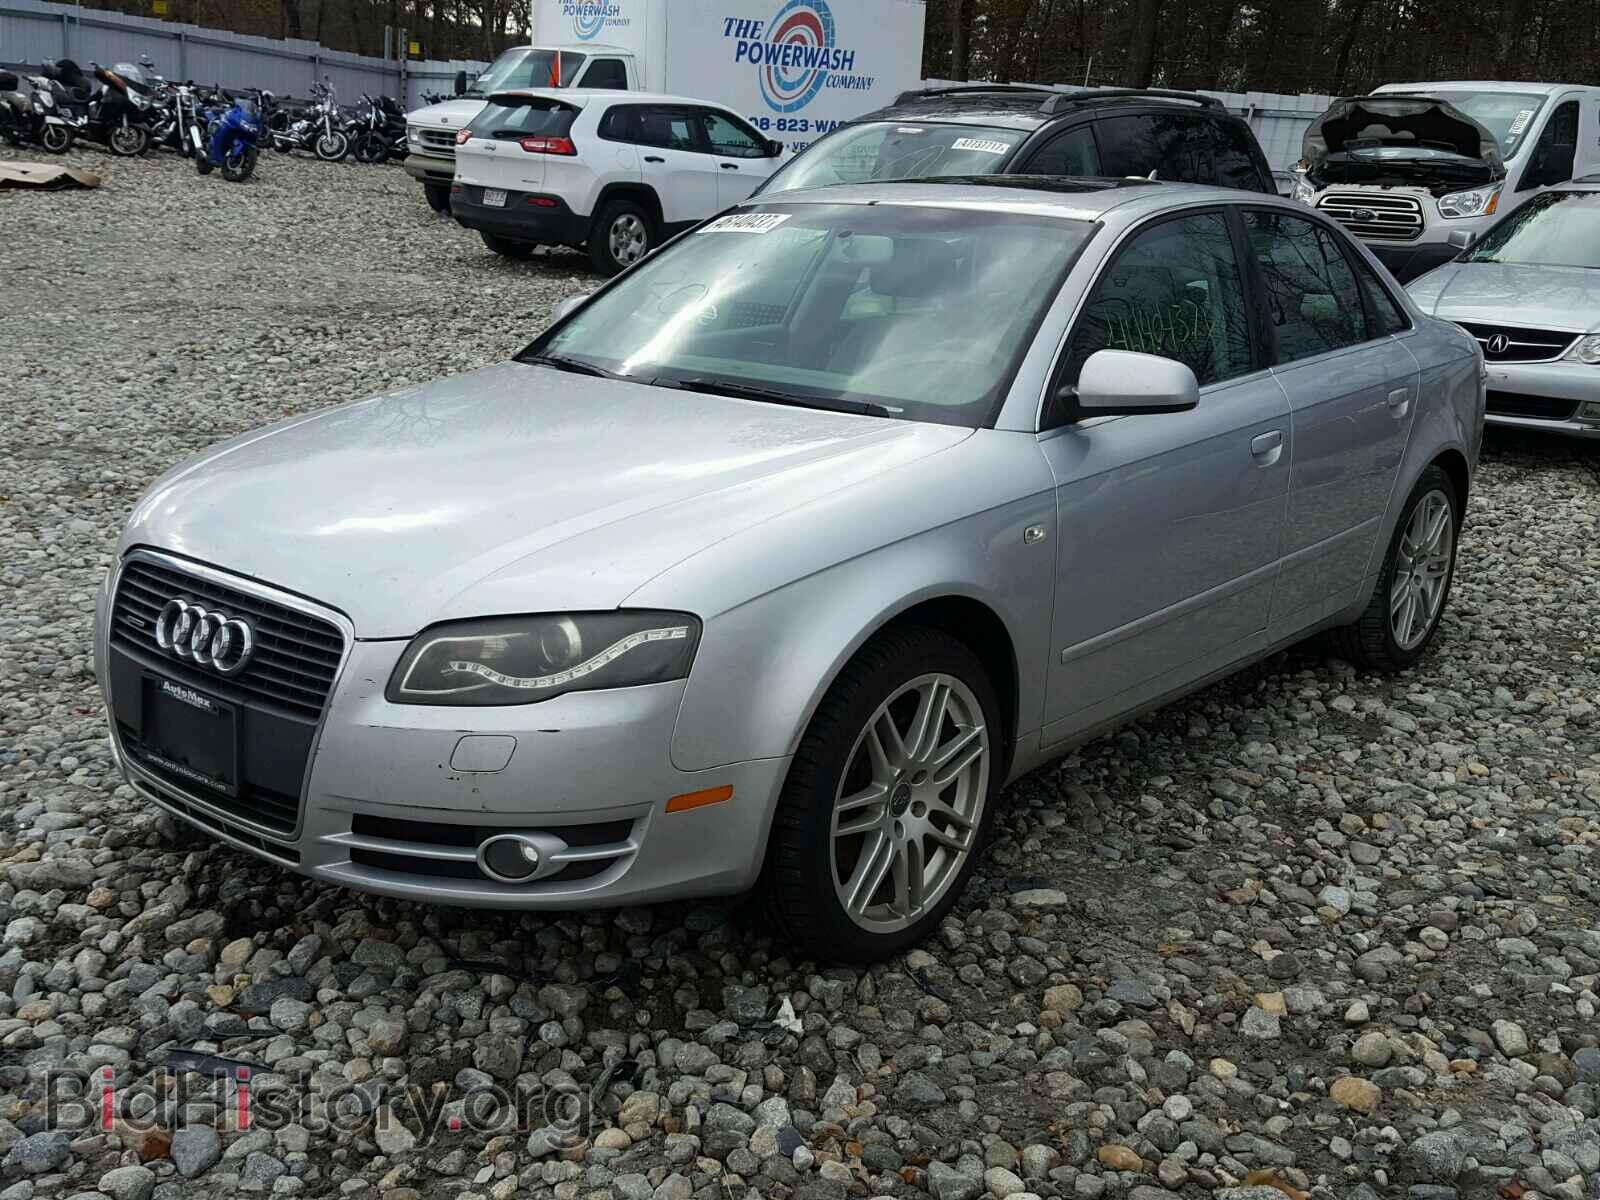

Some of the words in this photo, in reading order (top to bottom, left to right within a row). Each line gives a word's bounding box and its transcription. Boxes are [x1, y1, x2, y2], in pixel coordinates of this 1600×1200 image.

[562, 4, 620, 17] POWERWASH
[724, 17, 765, 40] THE
[735, 40, 856, 71] POWERWASH
[826, 73, 875, 91] COMPANY
[162, 680, 212, 708] AutoMax
